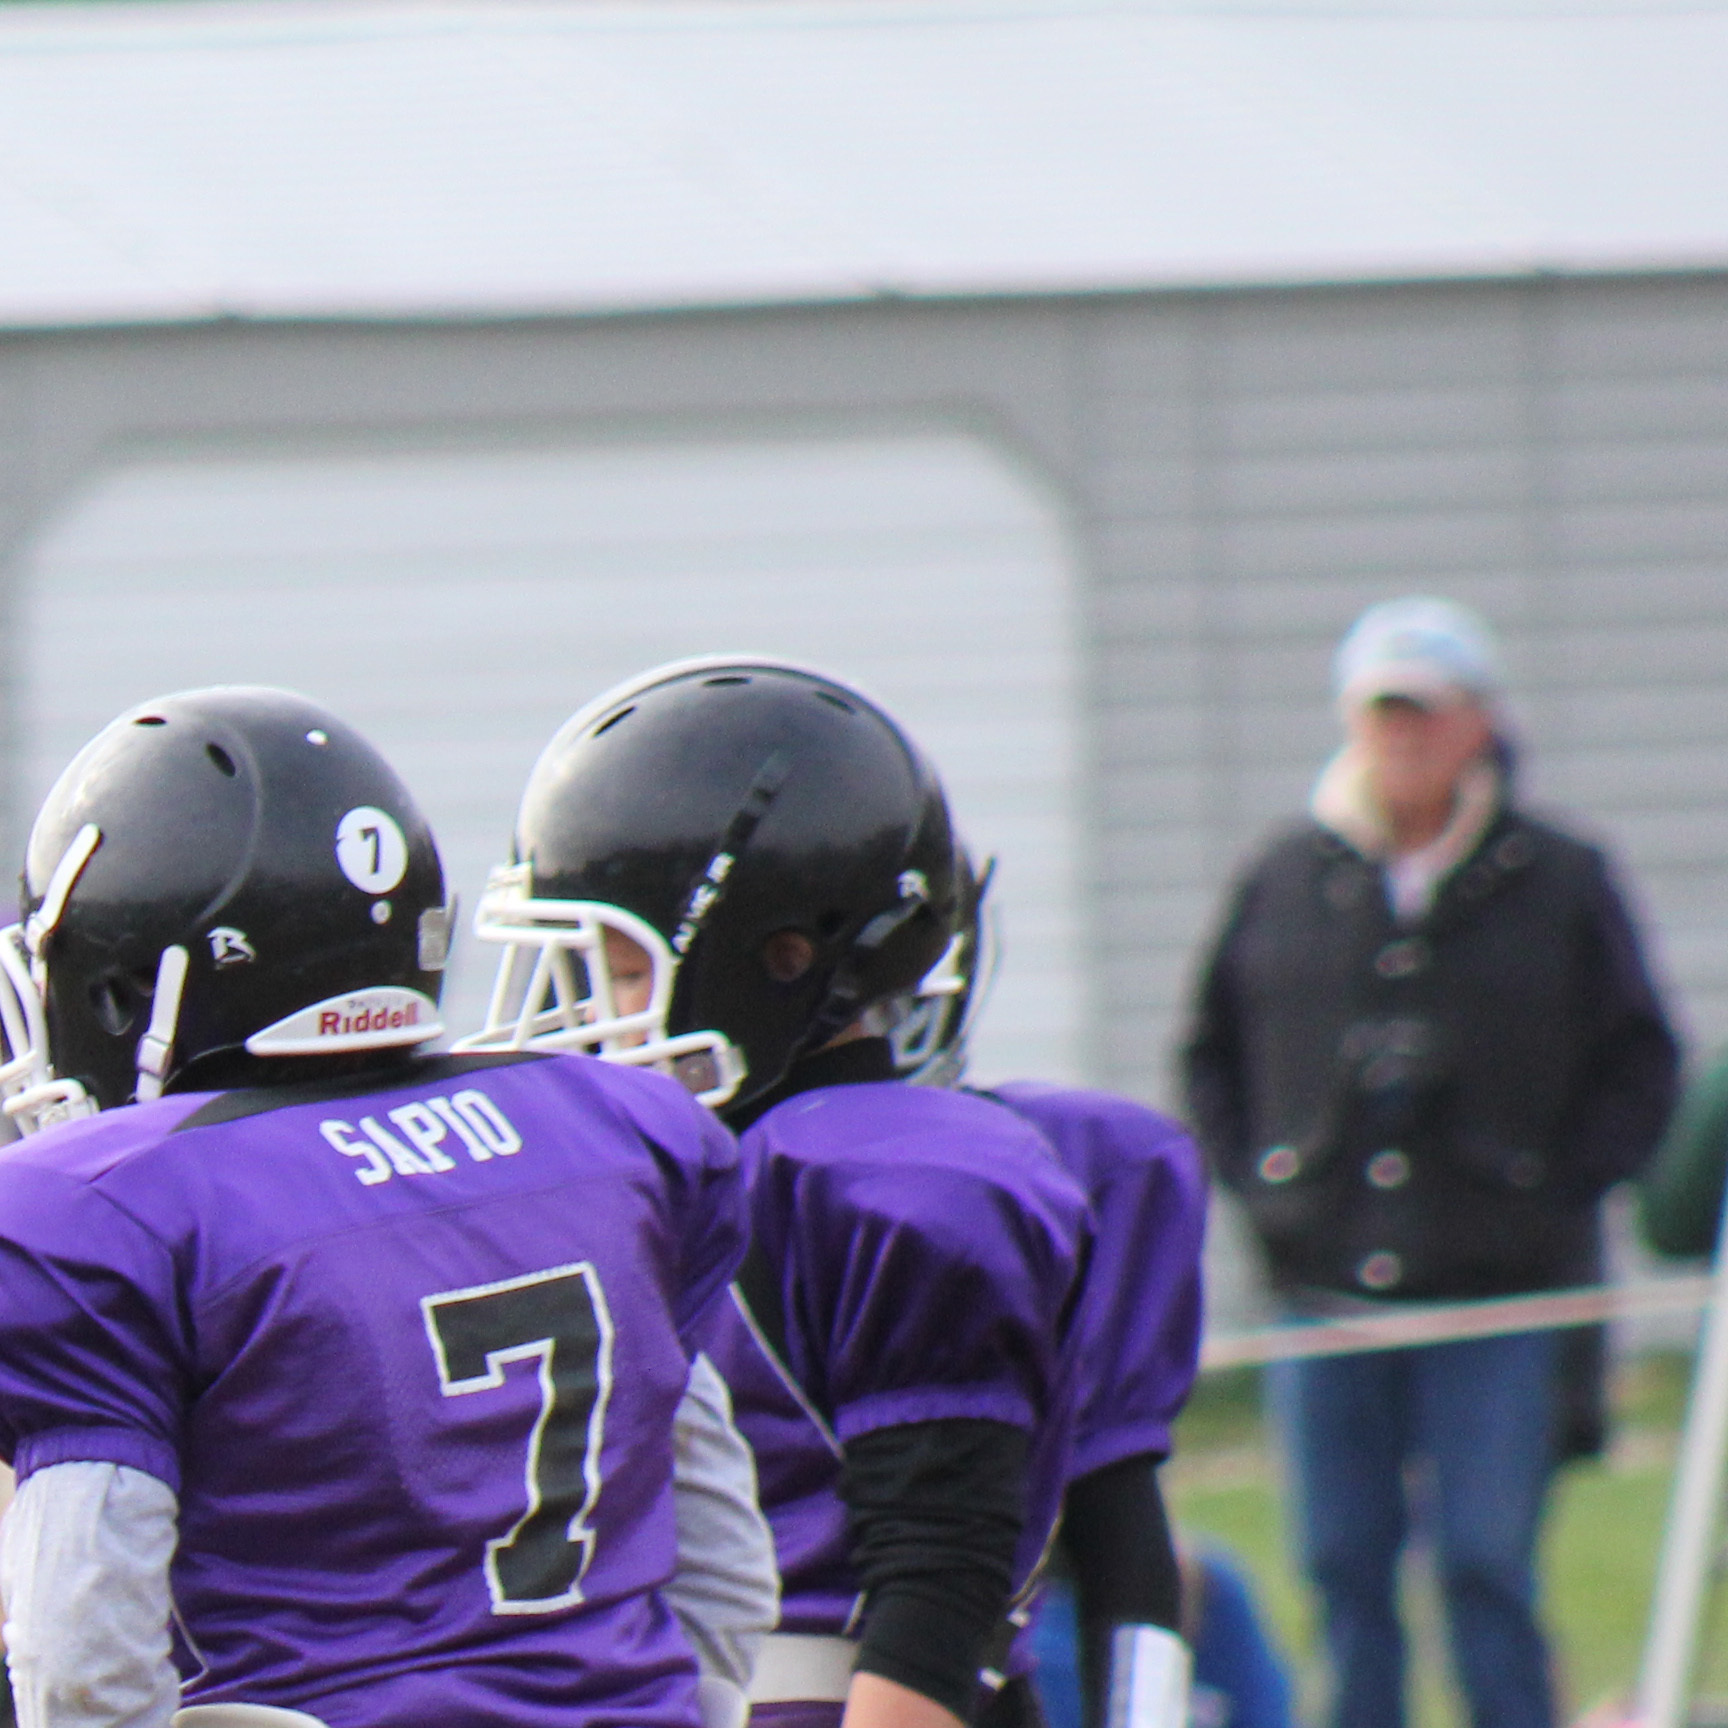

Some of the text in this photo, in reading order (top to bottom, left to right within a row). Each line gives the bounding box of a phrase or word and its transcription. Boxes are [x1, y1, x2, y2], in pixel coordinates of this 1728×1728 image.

[359, 827, 380, 874] 7
[319, 1002, 419, 1035] Riddell
[320, 1088, 522, 1186] SAPIO
[421, 1261, 614, 1615] 7
